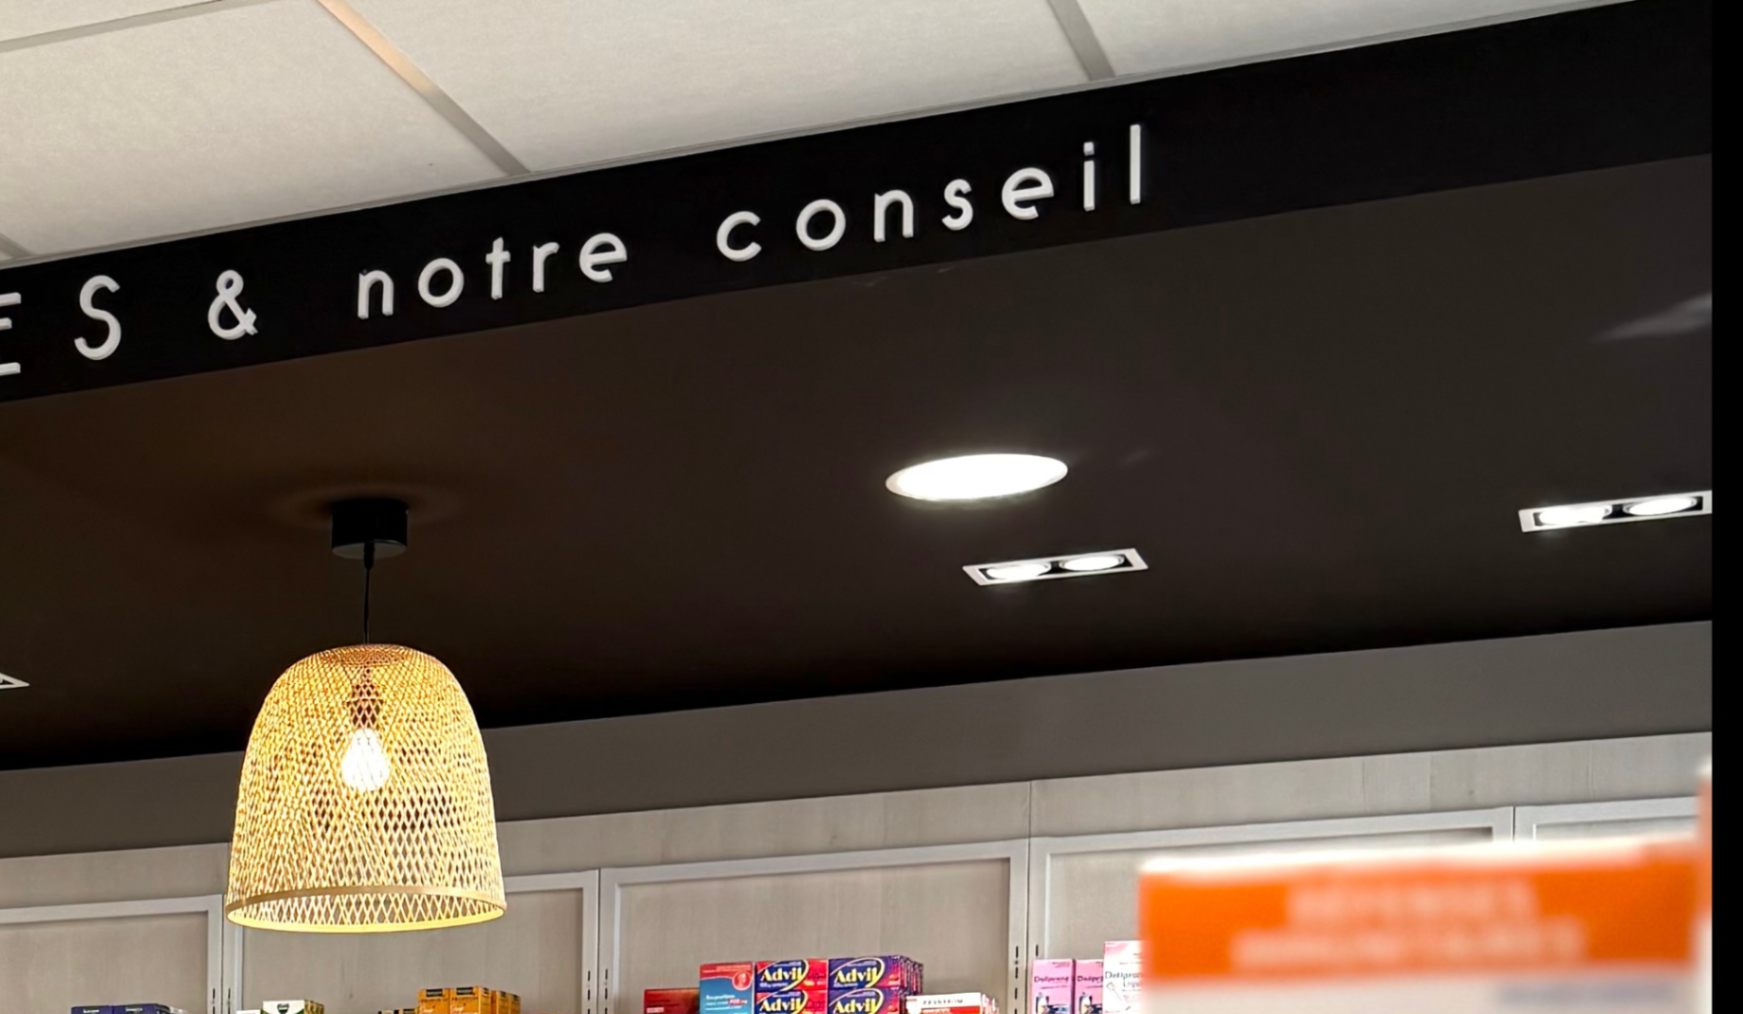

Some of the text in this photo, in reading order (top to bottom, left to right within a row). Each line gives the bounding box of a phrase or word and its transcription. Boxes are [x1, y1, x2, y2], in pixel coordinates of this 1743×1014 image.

[206, 270, 257, 340] &
[356, 232, 628, 318] notre
[715, 123, 1142, 262] conseil
[760, 965, 804, 983] Advil
[834, 966, 878, 984] Advil
[759, 995, 803, 1012] Advil
[833, 998, 877, 1014] Advil
